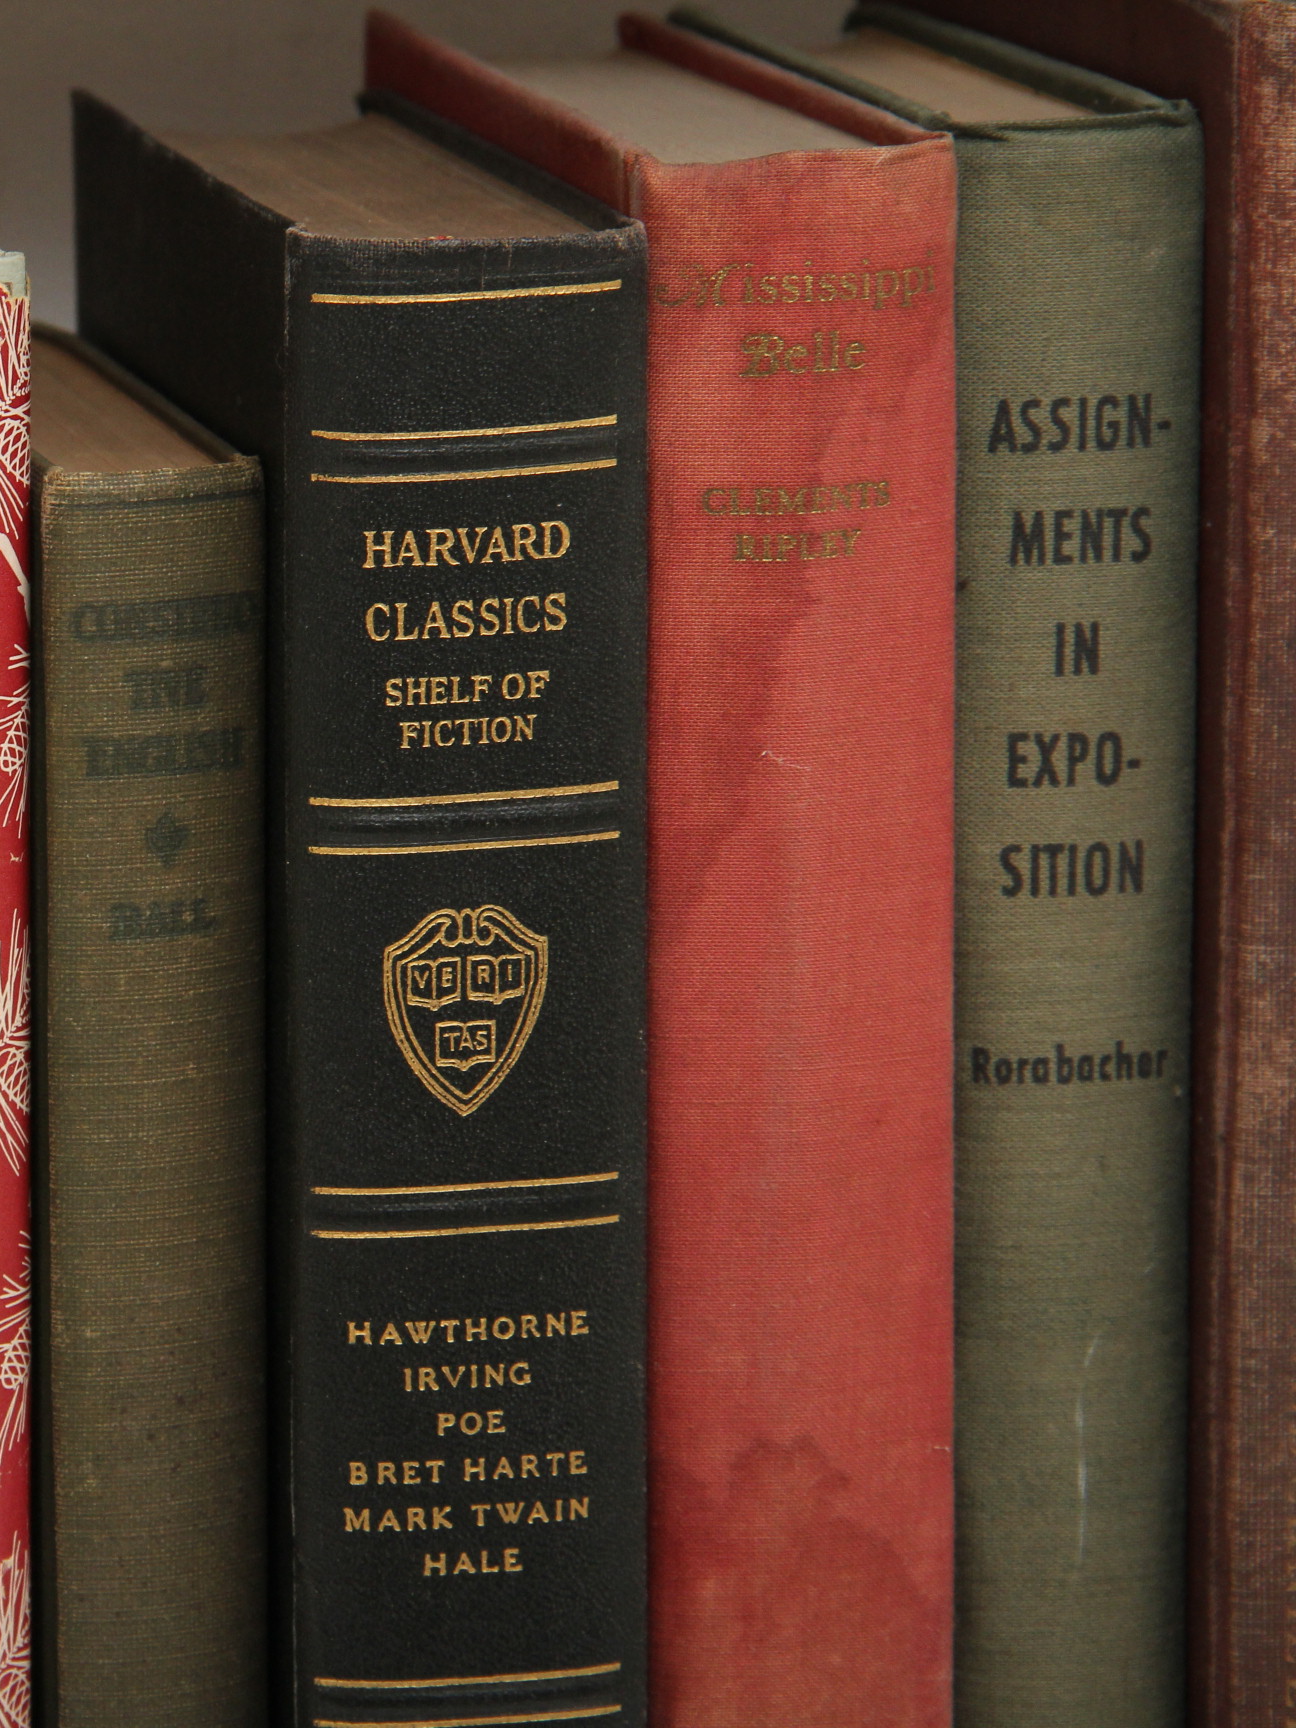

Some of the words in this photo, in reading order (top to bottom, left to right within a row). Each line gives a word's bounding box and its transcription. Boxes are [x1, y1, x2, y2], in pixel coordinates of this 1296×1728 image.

[654, 250, 937, 310] Mississippi
[739, 330, 867, 378] Belle
[986, 394, 1172, 455] ASSIGN-
[703, 480, 891, 516] CLEMENTS
[362, 520, 571, 569] HARVARD
[734, 529, 862, 562] RIPLEY
[1007, 506, 1153, 568] MENTS
[364, 592, 568, 642] CLASSICS
[1052, 621, 1101, 678] IN
[384, 674, 493, 707] SHELF
[501, 669, 551, 701] OF
[399, 713, 538, 749] FICTION
[1005, 730, 1142, 789] EXPO-
[998, 840, 1146, 899] SITION
[442, 1030, 488, 1053] TAS
[970, 1041, 1170, 1087] Rorabacher
[347, 1310, 590, 1346] HAWTHORNE
[404, 1361, 532, 1392] IRVING
[436, 1410, 507, 1437] POE
[349, 1459, 445, 1486] BRET
[463, 1450, 588, 1483] HARTE
[343, 1505, 453, 1533] MARK
[471, 1497, 590, 1528] TWAIN
[423, 1548, 524, 1577] HALE
